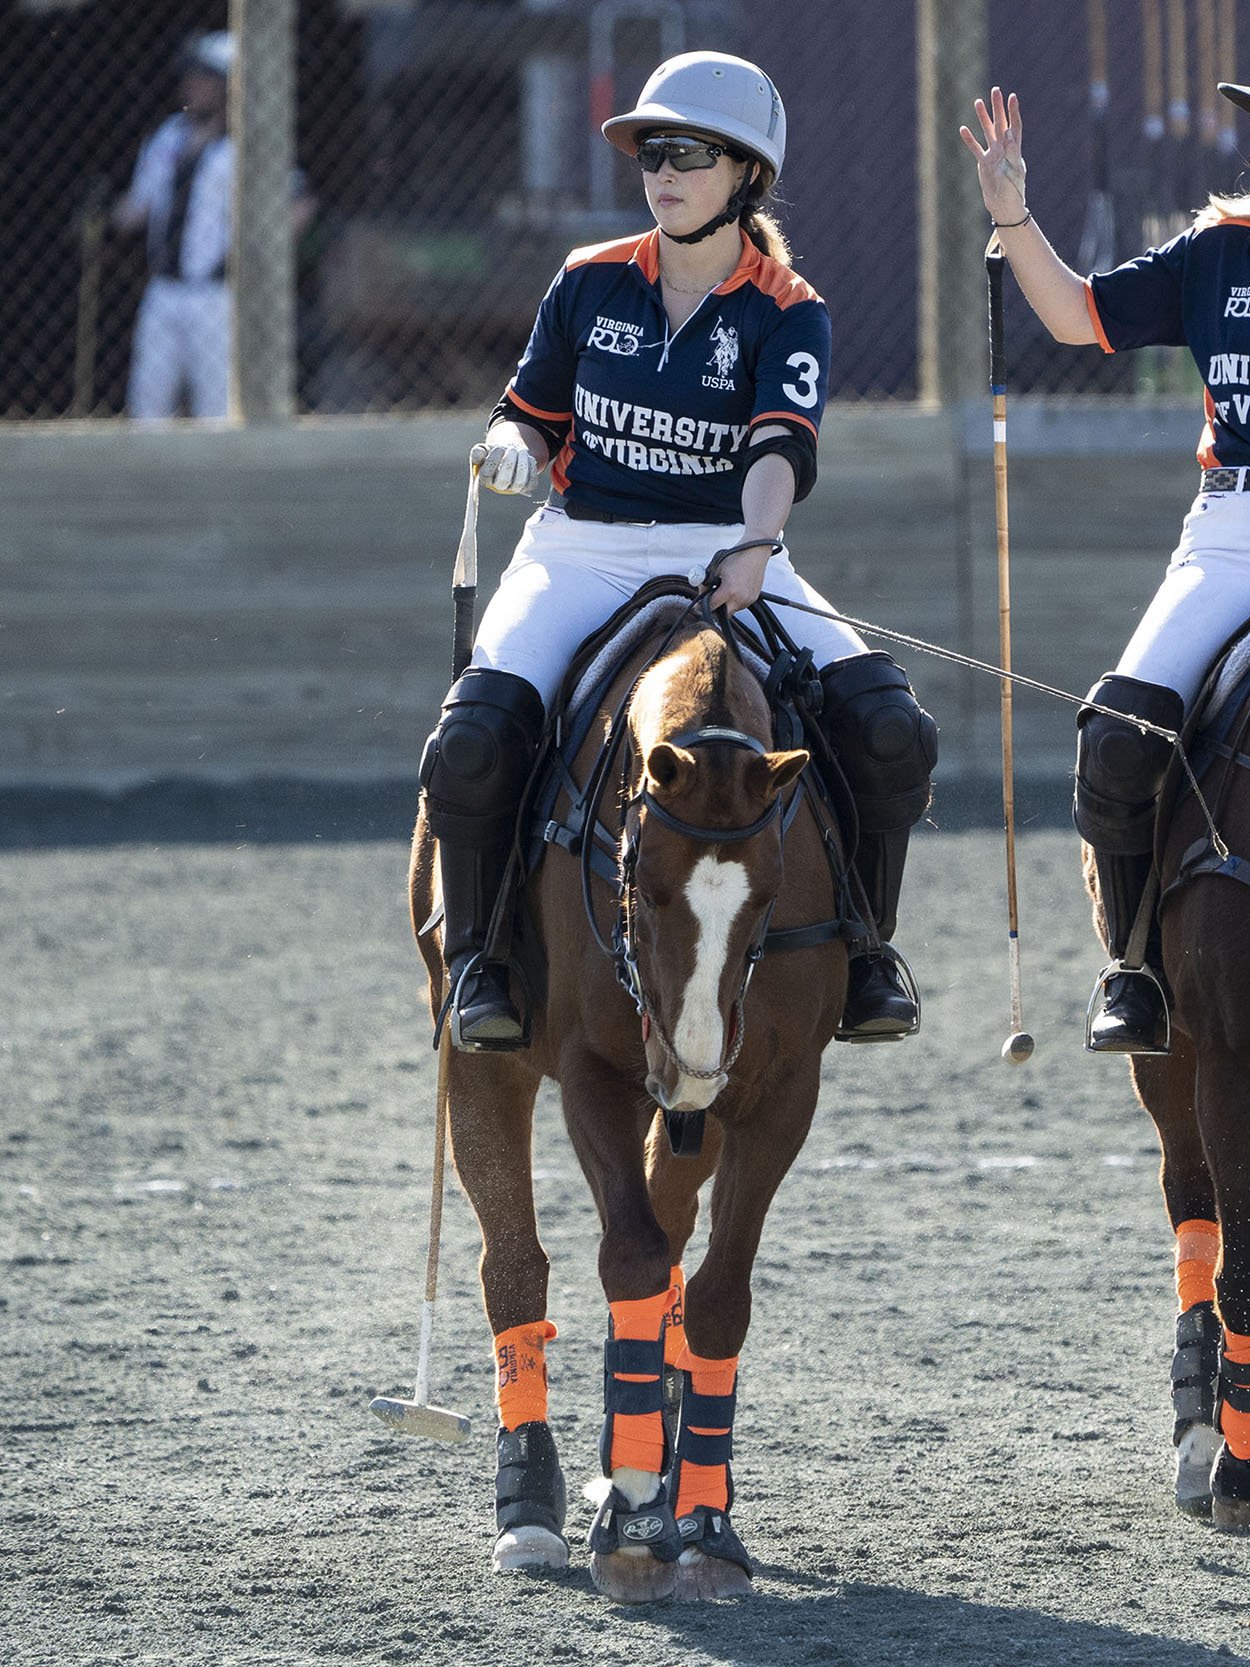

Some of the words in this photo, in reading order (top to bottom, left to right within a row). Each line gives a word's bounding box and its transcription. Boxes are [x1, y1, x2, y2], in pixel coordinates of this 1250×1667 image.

[596, 315, 644, 337] VIRGINIA
[701, 374, 736, 392] USPA
[782, 351, 820, 409] 3
[575, 383, 749, 453] UNIVERSITY
